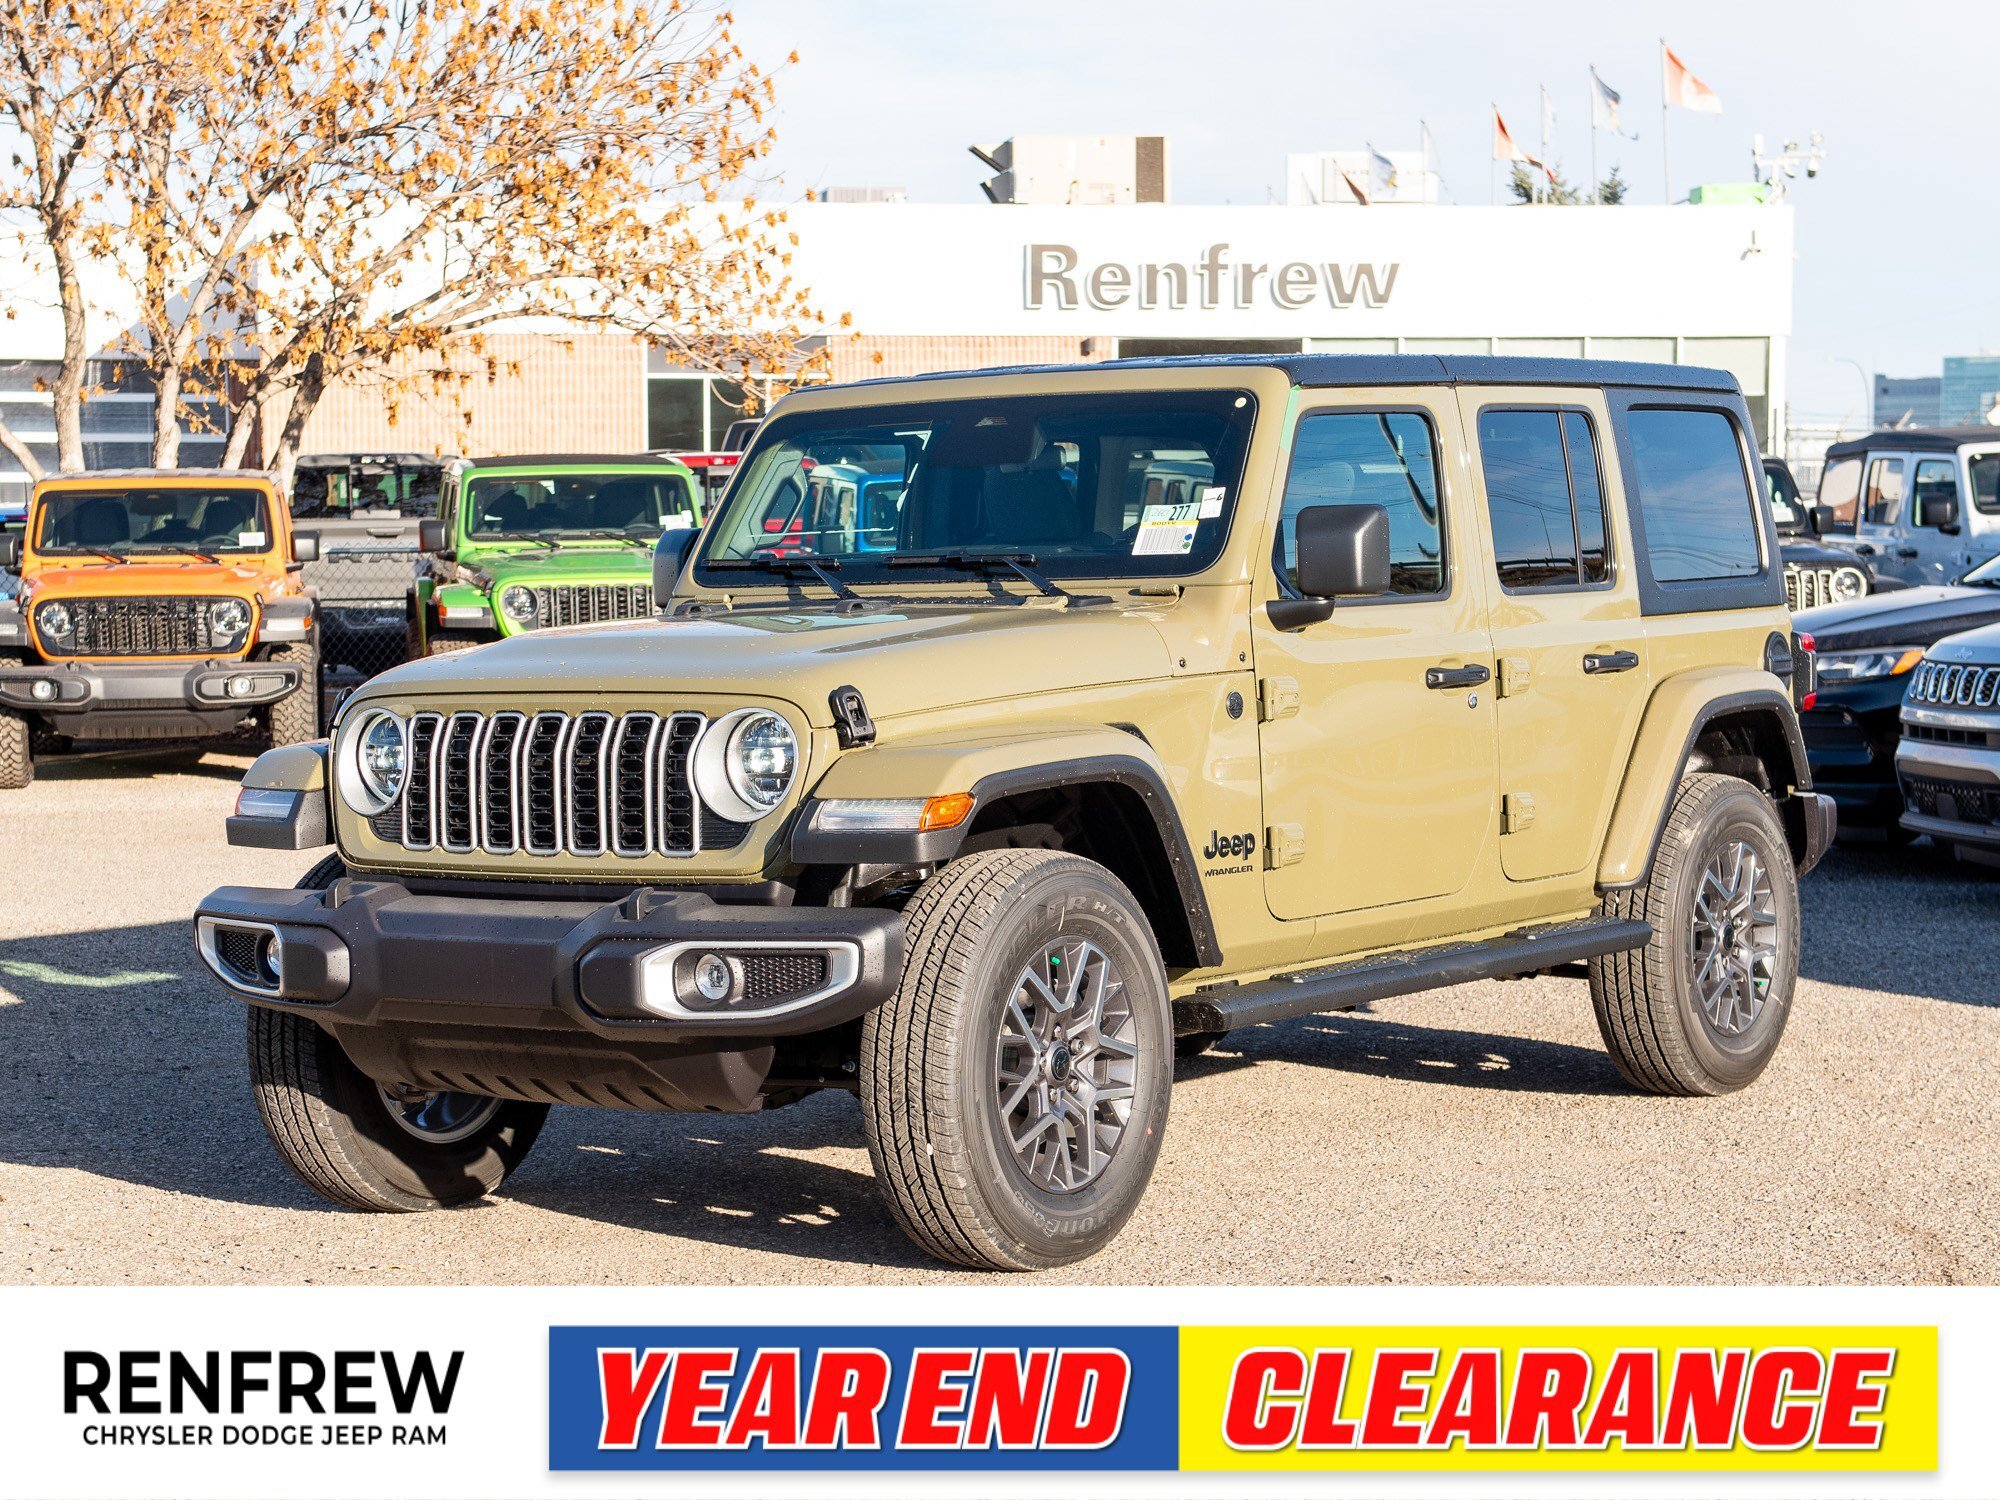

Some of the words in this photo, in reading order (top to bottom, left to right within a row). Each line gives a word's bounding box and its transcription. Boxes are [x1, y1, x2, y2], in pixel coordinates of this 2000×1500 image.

[1023, 243, 1400, 310] Renfrew
[1169, 504, 1191, 521] 277
[1203, 829, 1256, 861] Jeep
[1204, 865, 1254, 878] WRANGLER
